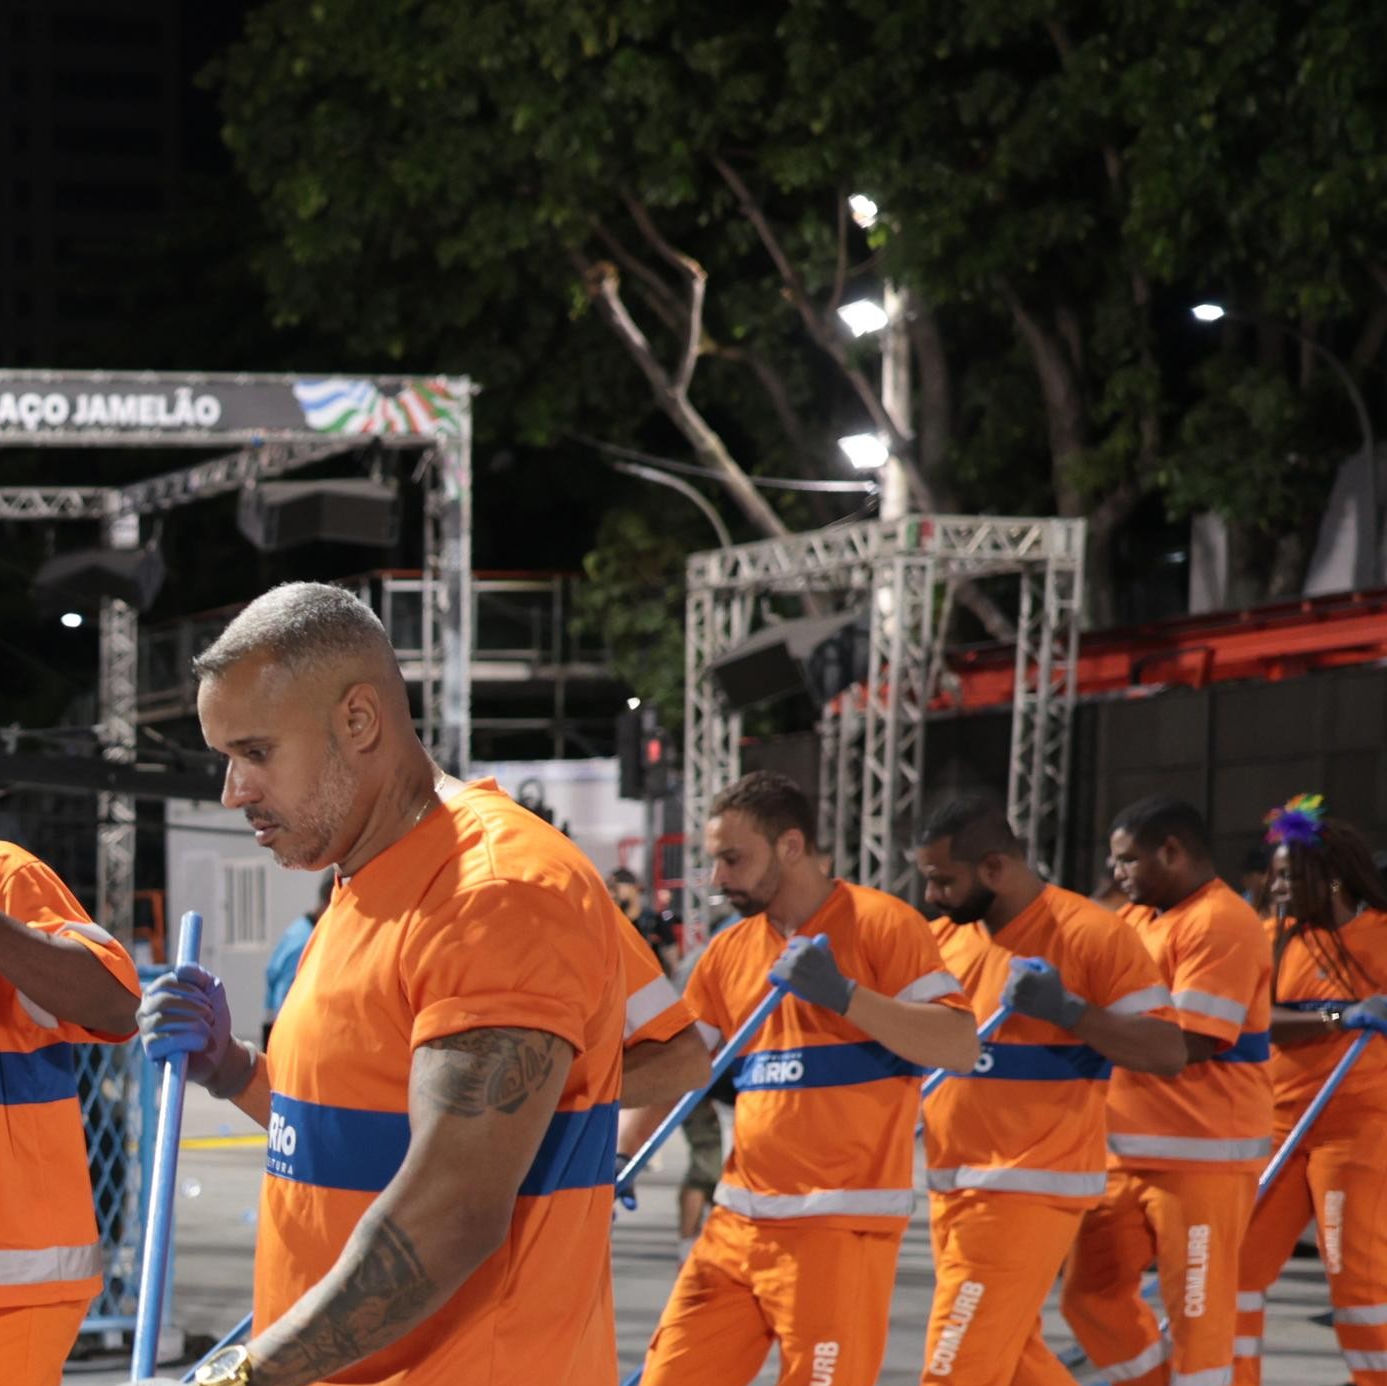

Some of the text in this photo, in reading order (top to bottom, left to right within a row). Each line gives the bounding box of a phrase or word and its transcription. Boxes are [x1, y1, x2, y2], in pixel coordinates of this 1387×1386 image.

[72, 386, 222, 427] JAMELÃO
[268, 1111, 297, 1157] Rio
[1183, 1223, 1211, 1318] COMLURB
[928, 1280, 986, 1376] COMLURB
